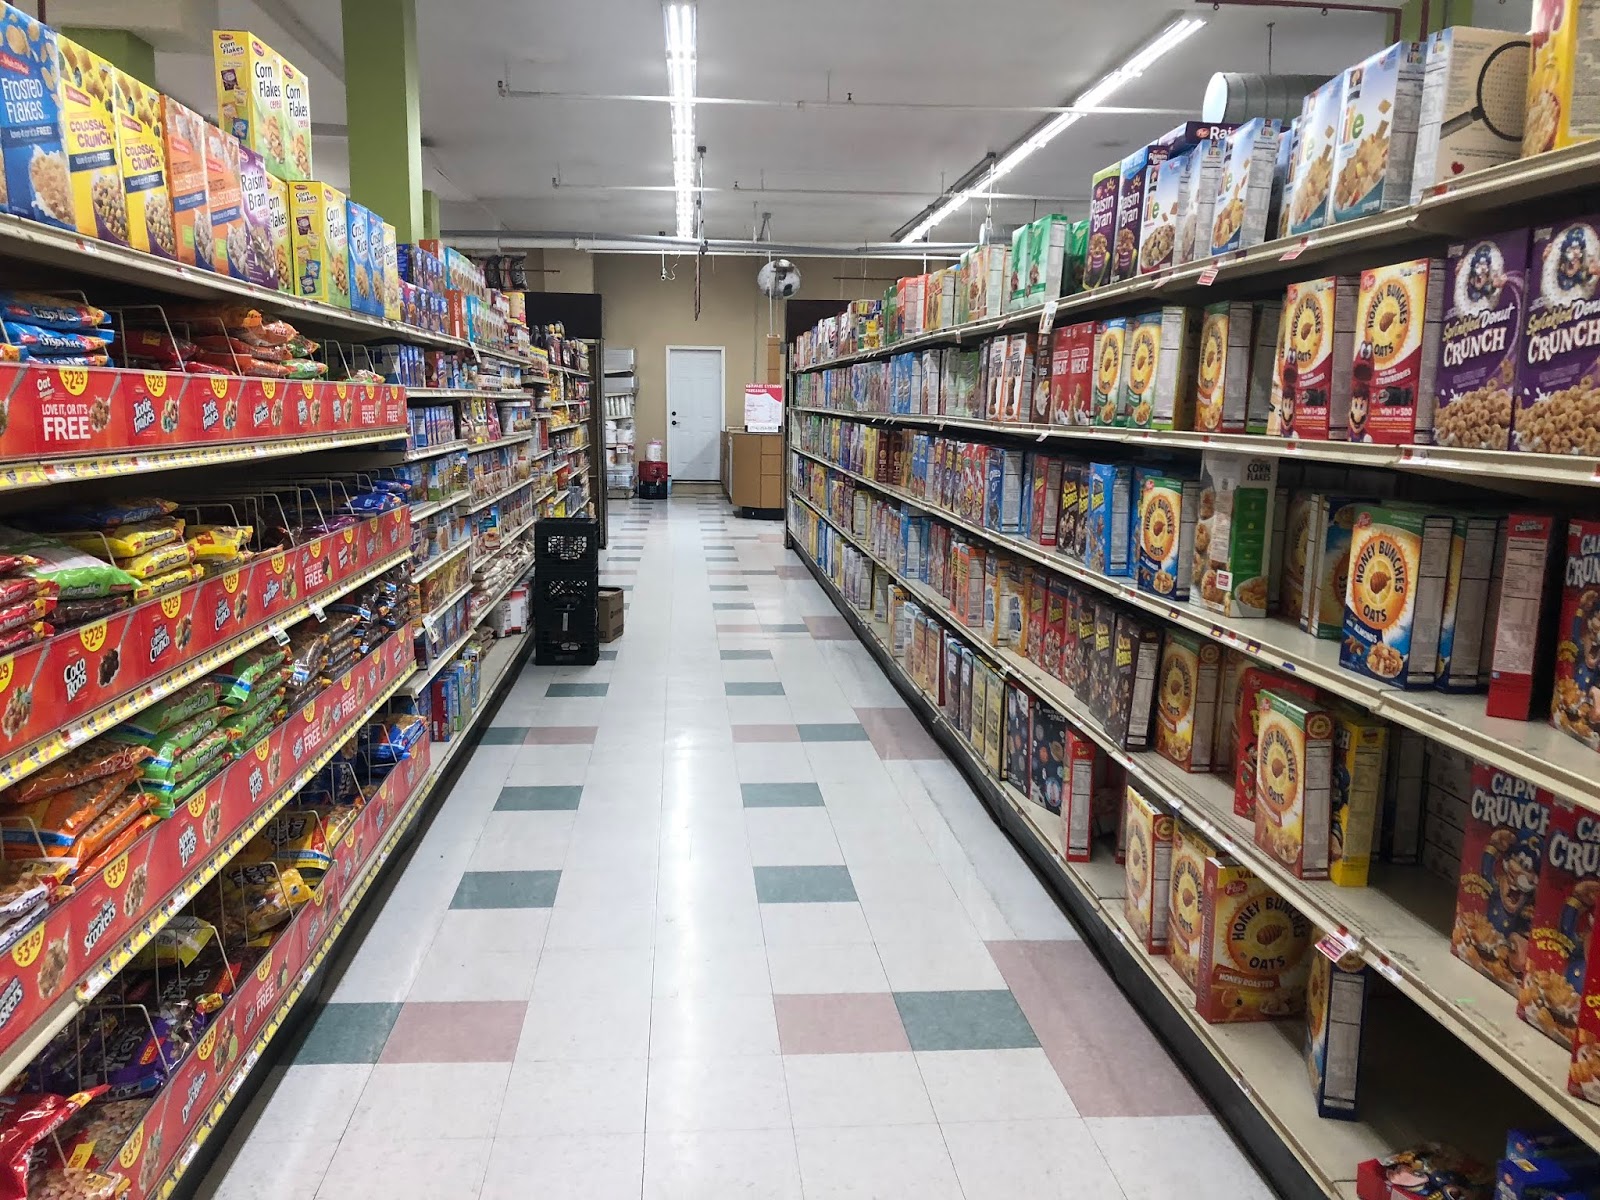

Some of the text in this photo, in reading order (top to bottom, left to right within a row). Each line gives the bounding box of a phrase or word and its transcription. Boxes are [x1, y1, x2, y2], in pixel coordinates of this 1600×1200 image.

[255, 62, 272, 78] Corn
[259, 81, 280, 98] Flakes
[286, 84, 300, 99] Corn
[289, 102, 307, 117] Flakes
[77, 133, 111, 148] CRUNCH
[132, 155, 160, 171] CRUNCH
[248, 193, 265, 211] Bran
[269, 196, 279, 209] orn
[1092, 193, 1114, 213] Raisin
[1120, 190, 1139, 212] Raisin
[327, 207, 339, 222] Corn
[1094, 210, 1112, 232] Bran
[1121, 208, 1138, 227] Bran
[330, 224, 346, 239] Flakes
[357, 240, 367, 254] Rice
[1367, 284, 1408, 329] HONEY BUNCHES
[1292, 303, 1304, 337] HONEY
[1480, 303, 1516, 328] Donut
[1374, 342, 1394, 358] OATS
[1443, 327, 1506, 368] CRUNCH
[1528, 320, 1600, 364] CRUNCH
[1297, 350, 1312, 362] OATS
[37, 376, 50, 391] Oat
[42, 404, 59, 415] LOVE
[66, 404, 76, 415] OR
[76, 404, 88, 414] IT'S
[387, 410, 398, 422] FREE
[362, 412, 375, 424] FREE
[43, 416, 91, 441] FREE
[1247, 463, 1271, 473] CORN
[1247, 473, 1270, 481] FLAKES
[1150, 544, 1164, 556] OATS
[1356, 539, 1404, 594] HONEY BUNCHES
[304, 569, 324, 590] FREE
[1363, 606, 1388, 622] OATS
[342, 694, 356, 718] FREE
[1167, 702, 1180, 716] OATS
[304, 726, 321, 753] FREE
[1276, 730, 1296, 784] BUNCHES
[1268, 786, 1284, 805] OATS
[1178, 913, 1193, 934] OATS
[1232, 900, 1260, 941] HONEY
[1250, 956, 1286, 970] OATS
[1219, 974, 1274, 988] HONEY ROASTED
[256, 983, 274, 1018] FREE
